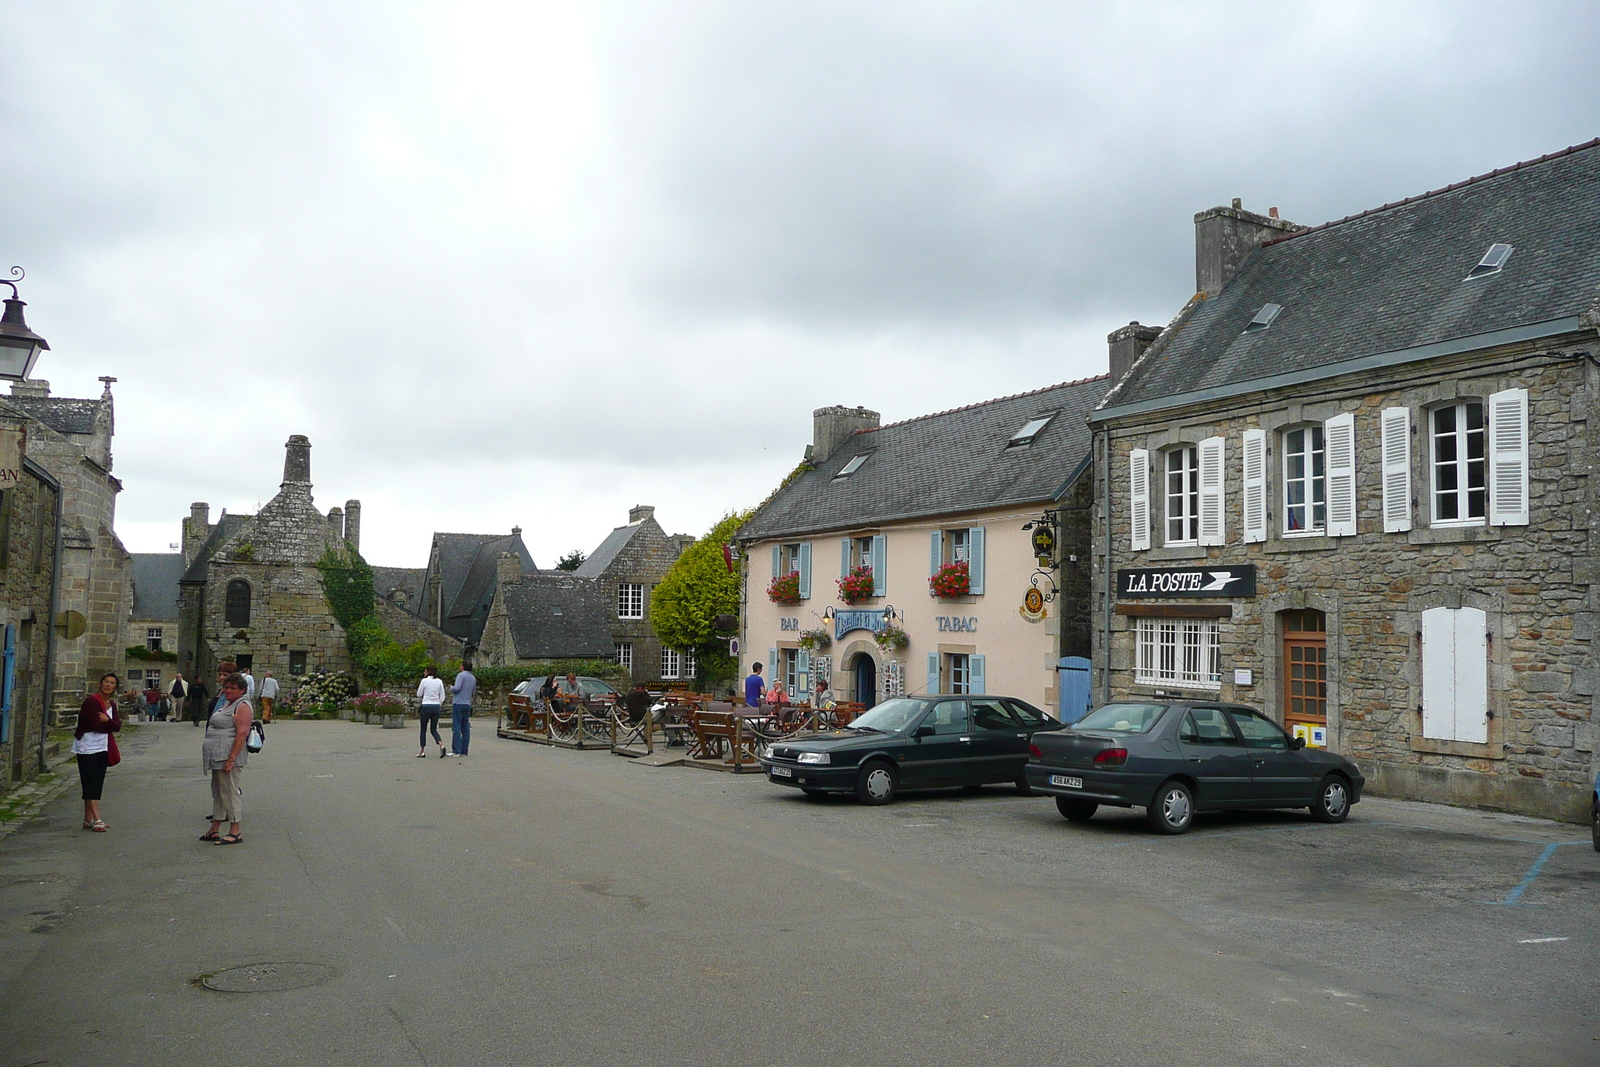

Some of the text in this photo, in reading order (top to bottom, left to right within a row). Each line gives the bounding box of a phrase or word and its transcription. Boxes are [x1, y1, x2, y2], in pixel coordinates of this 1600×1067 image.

[1126, 572, 1203, 592] LA POSTE
[780, 616, 799, 631] BAR
[935, 616, 978, 632] TABAC
